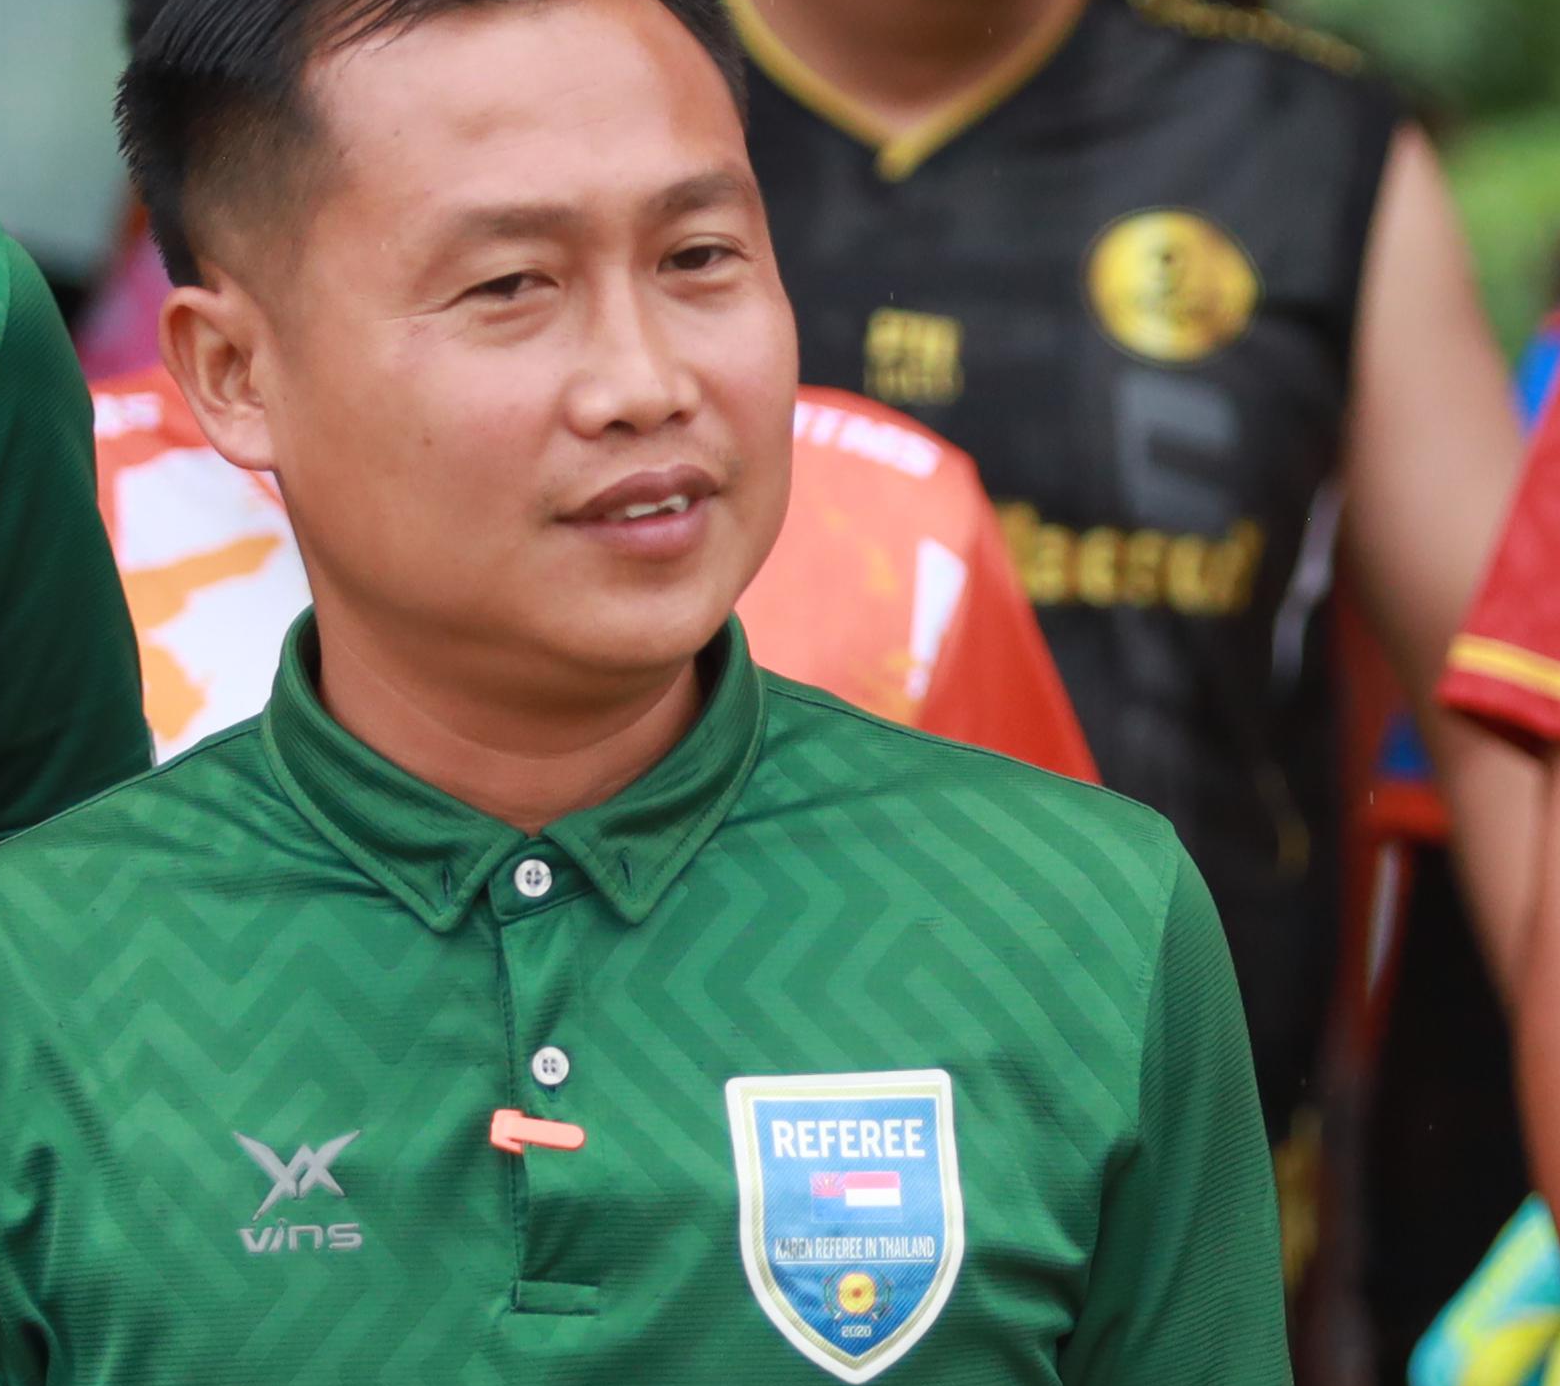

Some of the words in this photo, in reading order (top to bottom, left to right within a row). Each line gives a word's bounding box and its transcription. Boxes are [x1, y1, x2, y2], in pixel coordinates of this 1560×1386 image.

[771, 1119, 926, 1158] REFEREE
[775, 1236, 813, 1259] KAREN
[815, 1236, 863, 1259] REFEREE
[865, 1236, 877, 1257] IN
[879, 1235, 935, 1258] THAILAND
[841, 1324, 872, 1338] 2020
